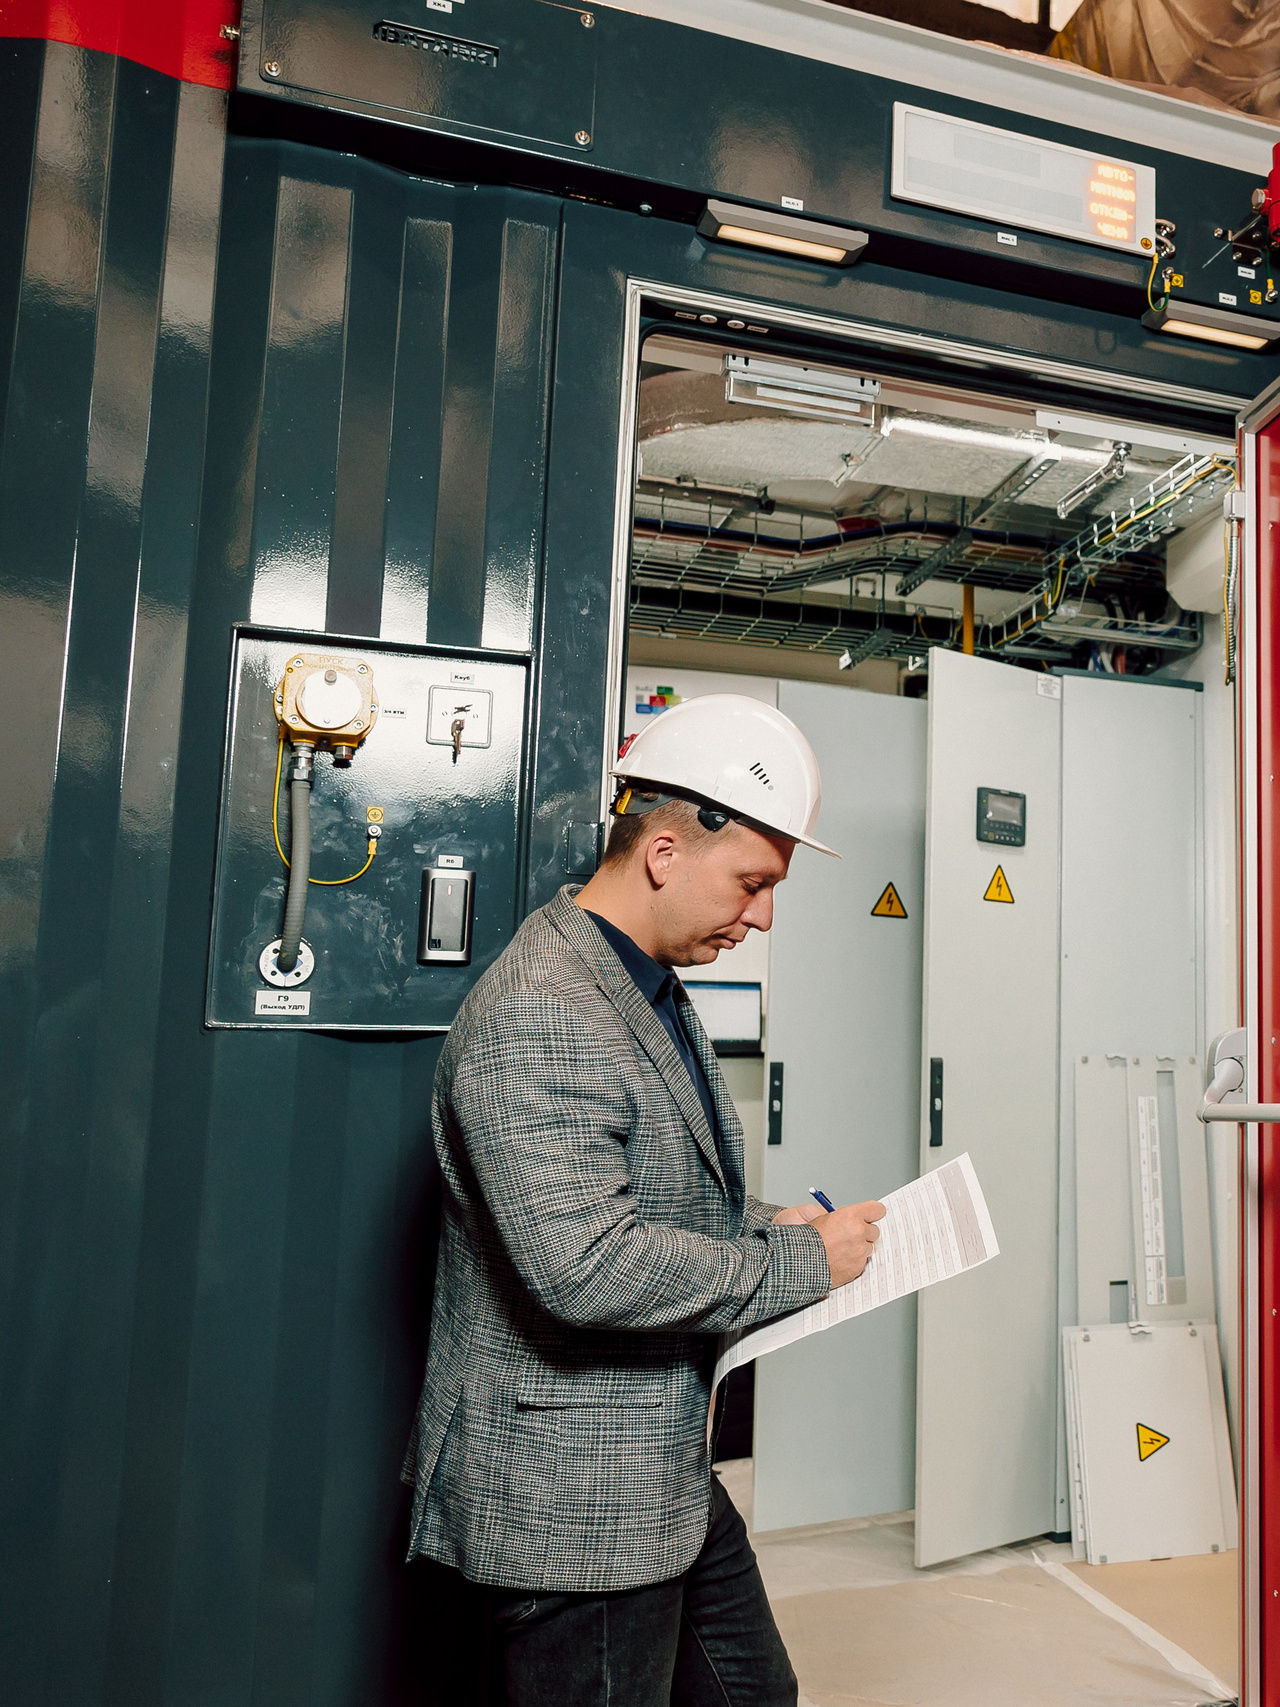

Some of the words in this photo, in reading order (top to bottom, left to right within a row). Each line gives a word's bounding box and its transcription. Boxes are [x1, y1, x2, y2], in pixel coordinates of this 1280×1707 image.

[1097, 165, 1134, 182] АВТО-
[1090, 181, 1135, 202] МАТИКА
[319, 656, 344, 665] ПУСК
